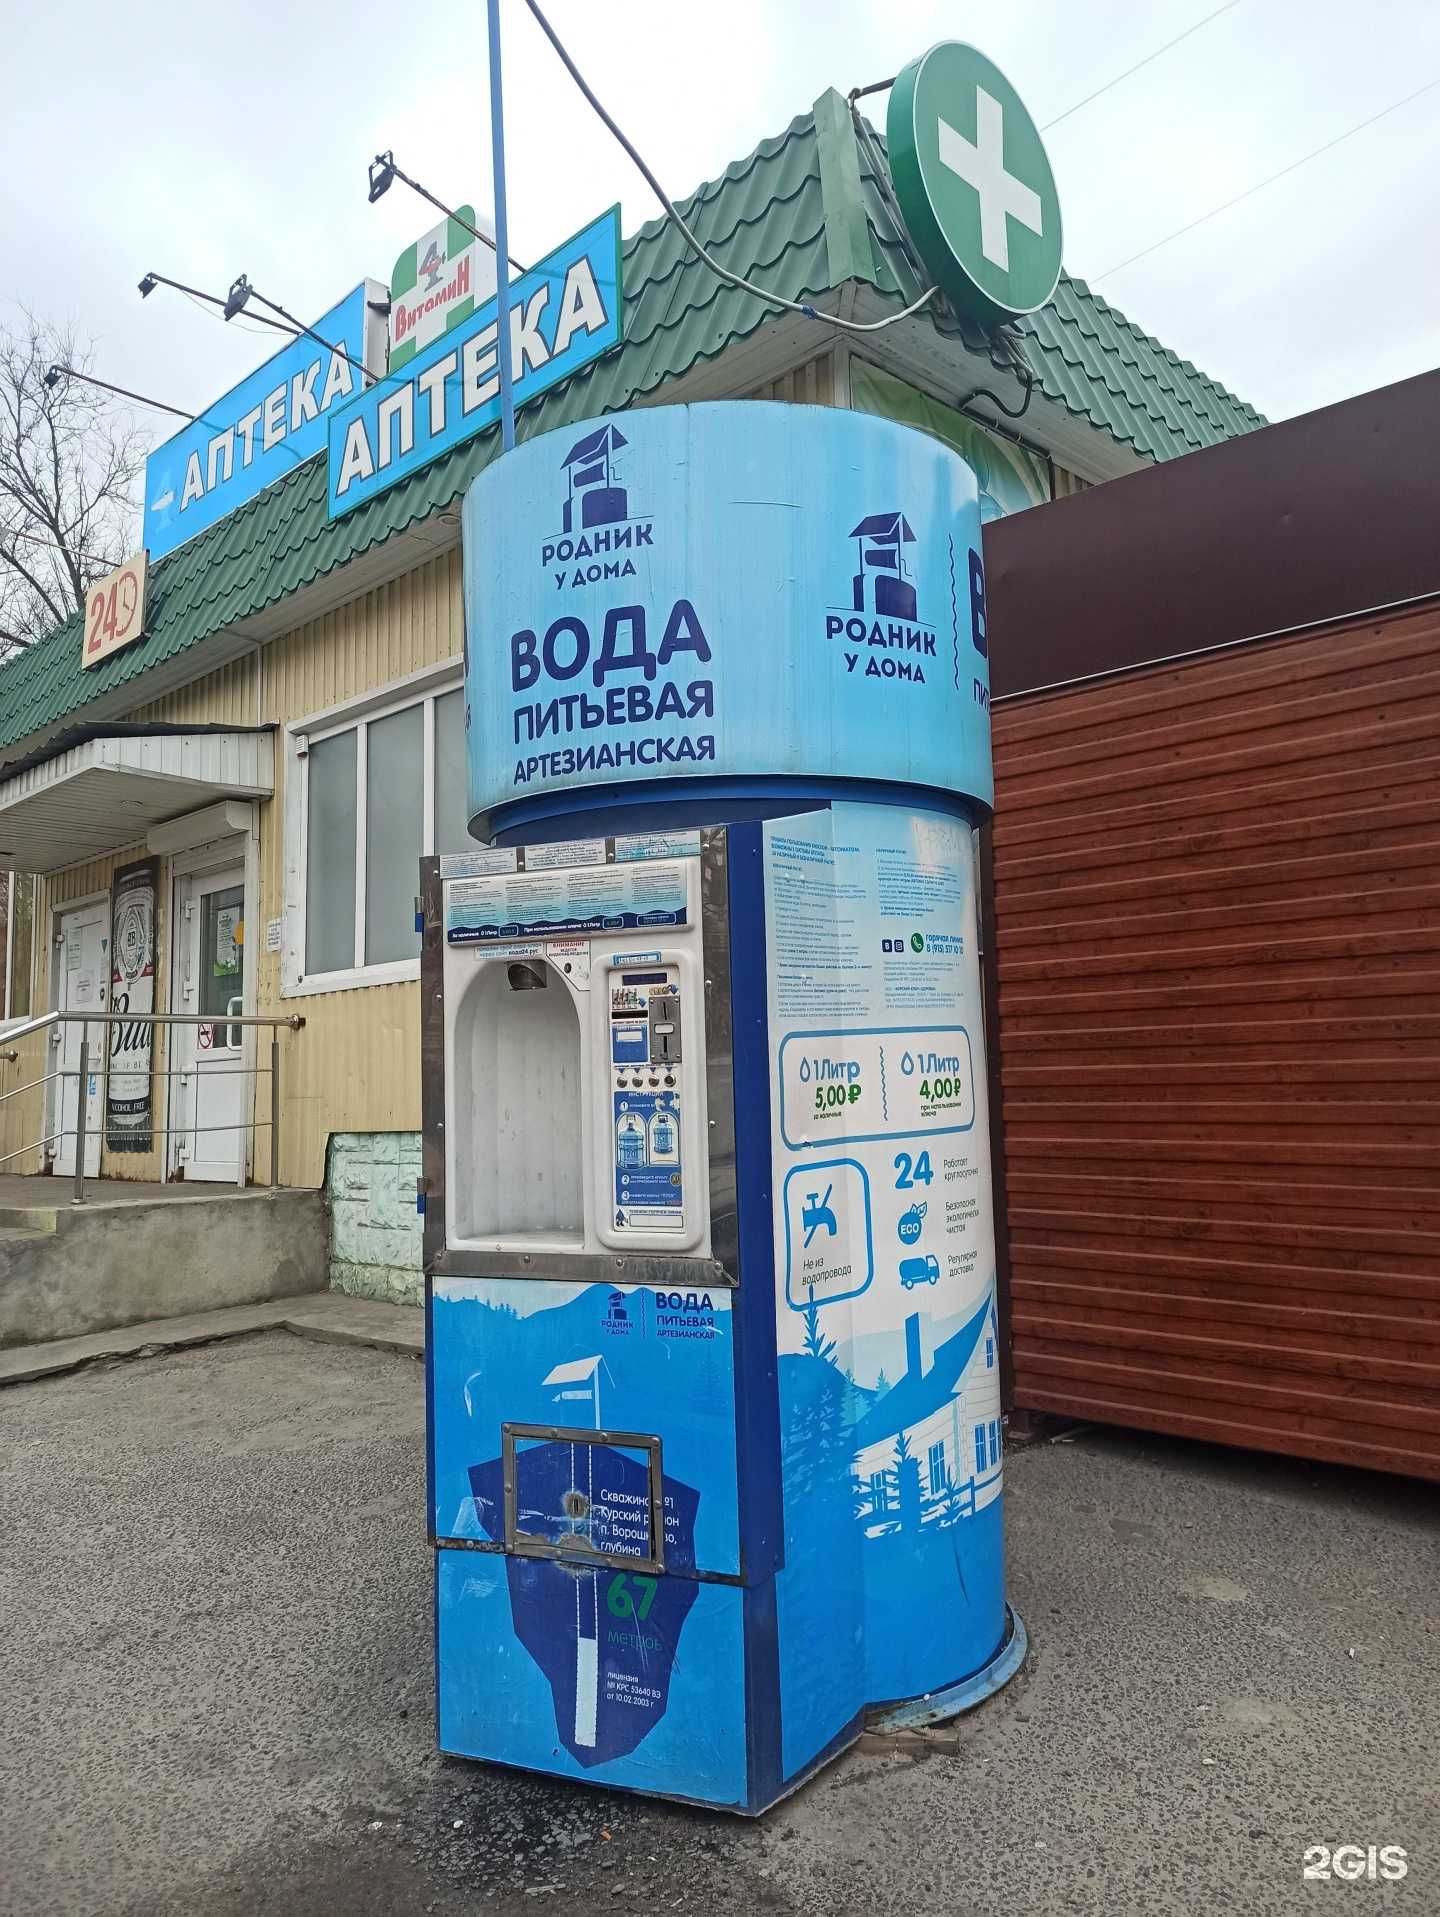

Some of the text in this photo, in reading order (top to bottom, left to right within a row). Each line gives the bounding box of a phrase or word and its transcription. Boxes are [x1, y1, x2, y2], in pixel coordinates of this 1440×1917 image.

[334, 254, 610, 498] АПТЕКА
[179, 340, 355, 513] АПТЕКА
[541, 523, 655, 568] РОДНИК
[555, 558, 637, 590] У ДОМА
[88, 582, 118, 654] 24
[511, 599, 712, 693] ВОДА
[826, 614, 937, 658] РОДНИК
[843, 652, 926, 684] У ДОМА
[513, 679, 715, 745] ПИТЬЕВАЯ
[513, 734, 716, 786] АРТЕЗИАНСКАЯ
[894, 1150, 934, 1189] 24
[900, 1223, 920, 1234] ECO
[802, 1265, 852, 1286] водопровода
[803, 1257, 824, 1270] Не из
[655, 1291, 714, 1314] ВОДА
[601, 1320, 635, 1329] РОДНИК
[656, 1314, 714, 1328] ПИТЬЕВАЯ
[656, 1329, 715, 1340] АРТЕЗИАНСКАЯ
[600, 1507, 641, 1523] Курский
[600, 1541, 641, 1557] глубина
[607, 1572, 658, 1621] 67
[607, 1671, 639, 1683] лицензия
[631, 1685, 651, 1697] 53640
